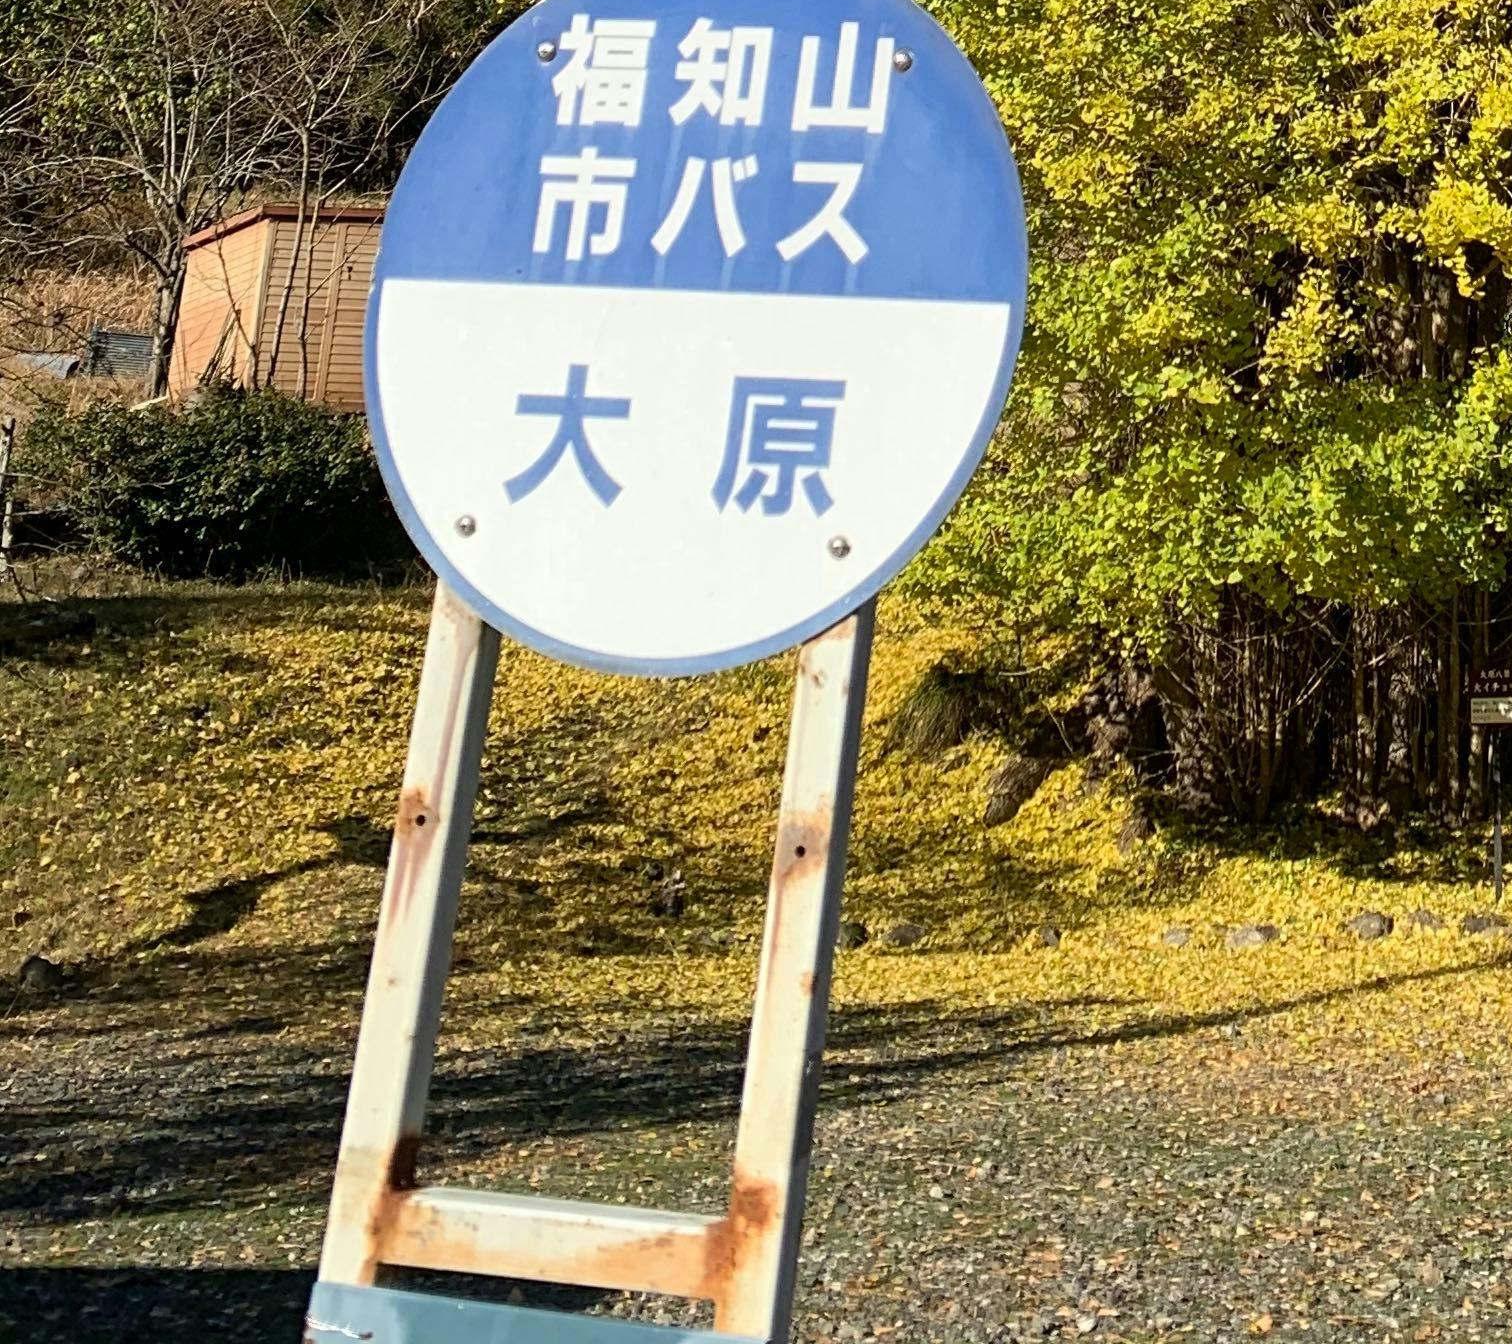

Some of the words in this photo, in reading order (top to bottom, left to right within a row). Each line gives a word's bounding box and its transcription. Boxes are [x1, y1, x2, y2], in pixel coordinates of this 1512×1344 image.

[550, 13, 896, 134] 福知山
[531, 146, 869, 265] 市バス
